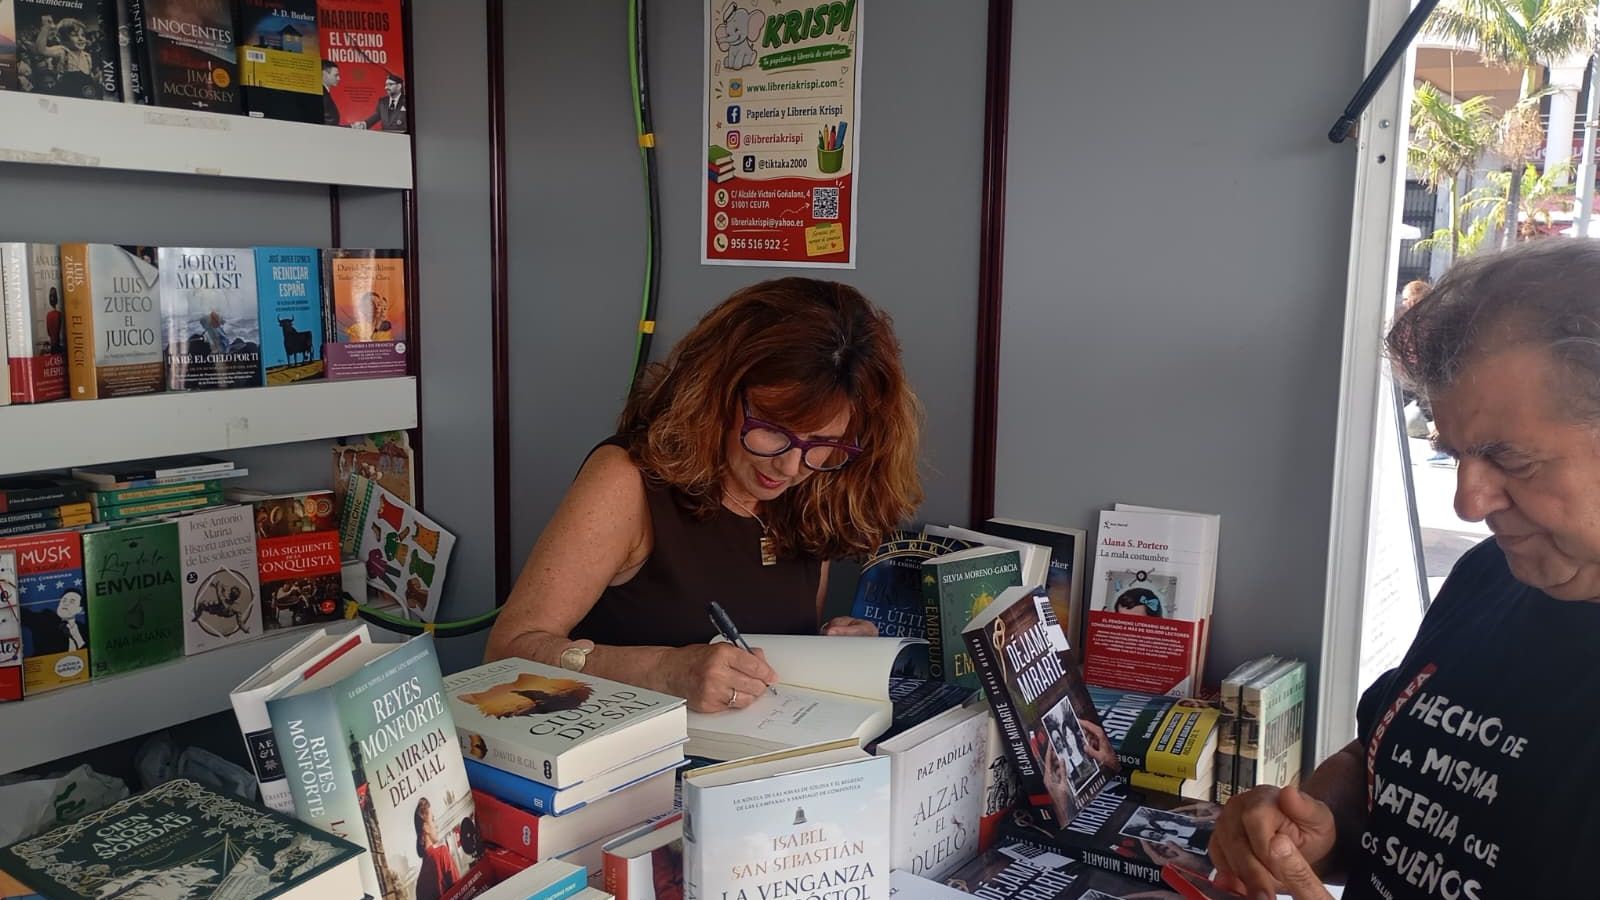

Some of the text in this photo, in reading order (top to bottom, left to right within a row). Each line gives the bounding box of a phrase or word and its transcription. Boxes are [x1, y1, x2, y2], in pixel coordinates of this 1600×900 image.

[271, 8, 315, 22] J. D. Barker
[321, 9, 391, 32] MARRUECOS
[762, 0, 856, 48] KRISPI
[152, 17, 232, 43] INOCENTES
[329, 32, 384, 48] EL VECINO
[328, 48, 387, 65] INCÓMODO
[103, 60, 116, 92] ÓNIX
[186, 68, 205, 83] JIM
[746, 79, 838, 93] www.libreriakrispi.com
[746, 104, 843, 119] Papelería y Librería Krispi
[744, 132, 804, 146] @libreriakrispi
[758, 159, 808, 170] @tiktaka2000
[731, 190, 738, 198] C/
[738, 190, 757, 198] Alcalde
[731, 201, 749, 209] 51001
[731, 218, 804, 229] libreriakrispi@yahoo.es
[730, 239, 781, 249] 956 516 922
[64, 255, 75, 292] ZUECO
[73, 262, 83, 285] LUIS
[178, 254, 237, 271] JORGE
[272, 266, 309, 281] REINICIAR
[113, 277, 143, 293] LUIS
[176, 273, 242, 290] MOLIST
[279, 281, 306, 297] ESPAÑA
[104, 296, 152, 314] ZUECO
[72, 315, 83, 328] EL
[124, 315, 135, 327] EL
[106, 328, 154, 352] JUICIO
[194, 352, 259, 364] EL CIELO POR TI
[190, 512, 243, 532] José Antonio
[203, 528, 232, 540] Marina
[1101, 537, 1169, 551] Alana S. Portero
[20, 545, 72, 566] MUSK
[184, 542, 217, 555] Historia
[261, 541, 333, 558] DÍA SIGUIENTE
[1100, 549, 1170, 563] La mala costumbre
[185, 556, 197, 567] de
[198, 554, 210, 565] las
[1049, 560, 1070, 570] rker
[95, 570, 176, 597] ENVIDIA
[942, 573, 964, 584] SILVIA
[864, 606, 925, 629] EL ÚLTI
[878, 622, 925, 638] ECRET
[924, 606, 942, 678] EMBRUJO
[1006, 621, 1053, 673] DÉJAME
[1017, 649, 1067, 705] MIRARTE
[372, 676, 422, 724] REYES
[529, 690, 638, 736] CIUDAD
[557, 699, 660, 741] DE SAL
[996, 701, 1020, 744] MIRARTE
[360, 691, 445, 764] MONFORTE
[1409, 692, 1528, 759] HECHO DE
[288, 719, 326, 818] MONFORTE
[310, 735, 337, 793] REYES
[376, 727, 447, 790] LA MIRADA
[916, 742, 974, 782] PAZ PADILLA
[389, 755, 446, 809] DEL MAL
[1391, 744, 1499, 805] LA MISMA
[914, 775, 970, 827] ALZAR
[1066, 788, 1128, 836] MIRARTE
[95, 812, 150, 840] CIEN
[155, 811, 181, 825] DE
[936, 816, 945, 834] EL
[772, 827, 827, 852] ISABEL
[911, 825, 968, 875] DUELO
[1361, 831, 1379, 855] OS
[731, 840, 865, 881] SAN SEBASTIÁN
[1082, 850, 1161, 883] DÉJAME MIRARTE
[757, 862, 875, 900] VENGANZA
[1012, 866, 1079, 900] RARTE
